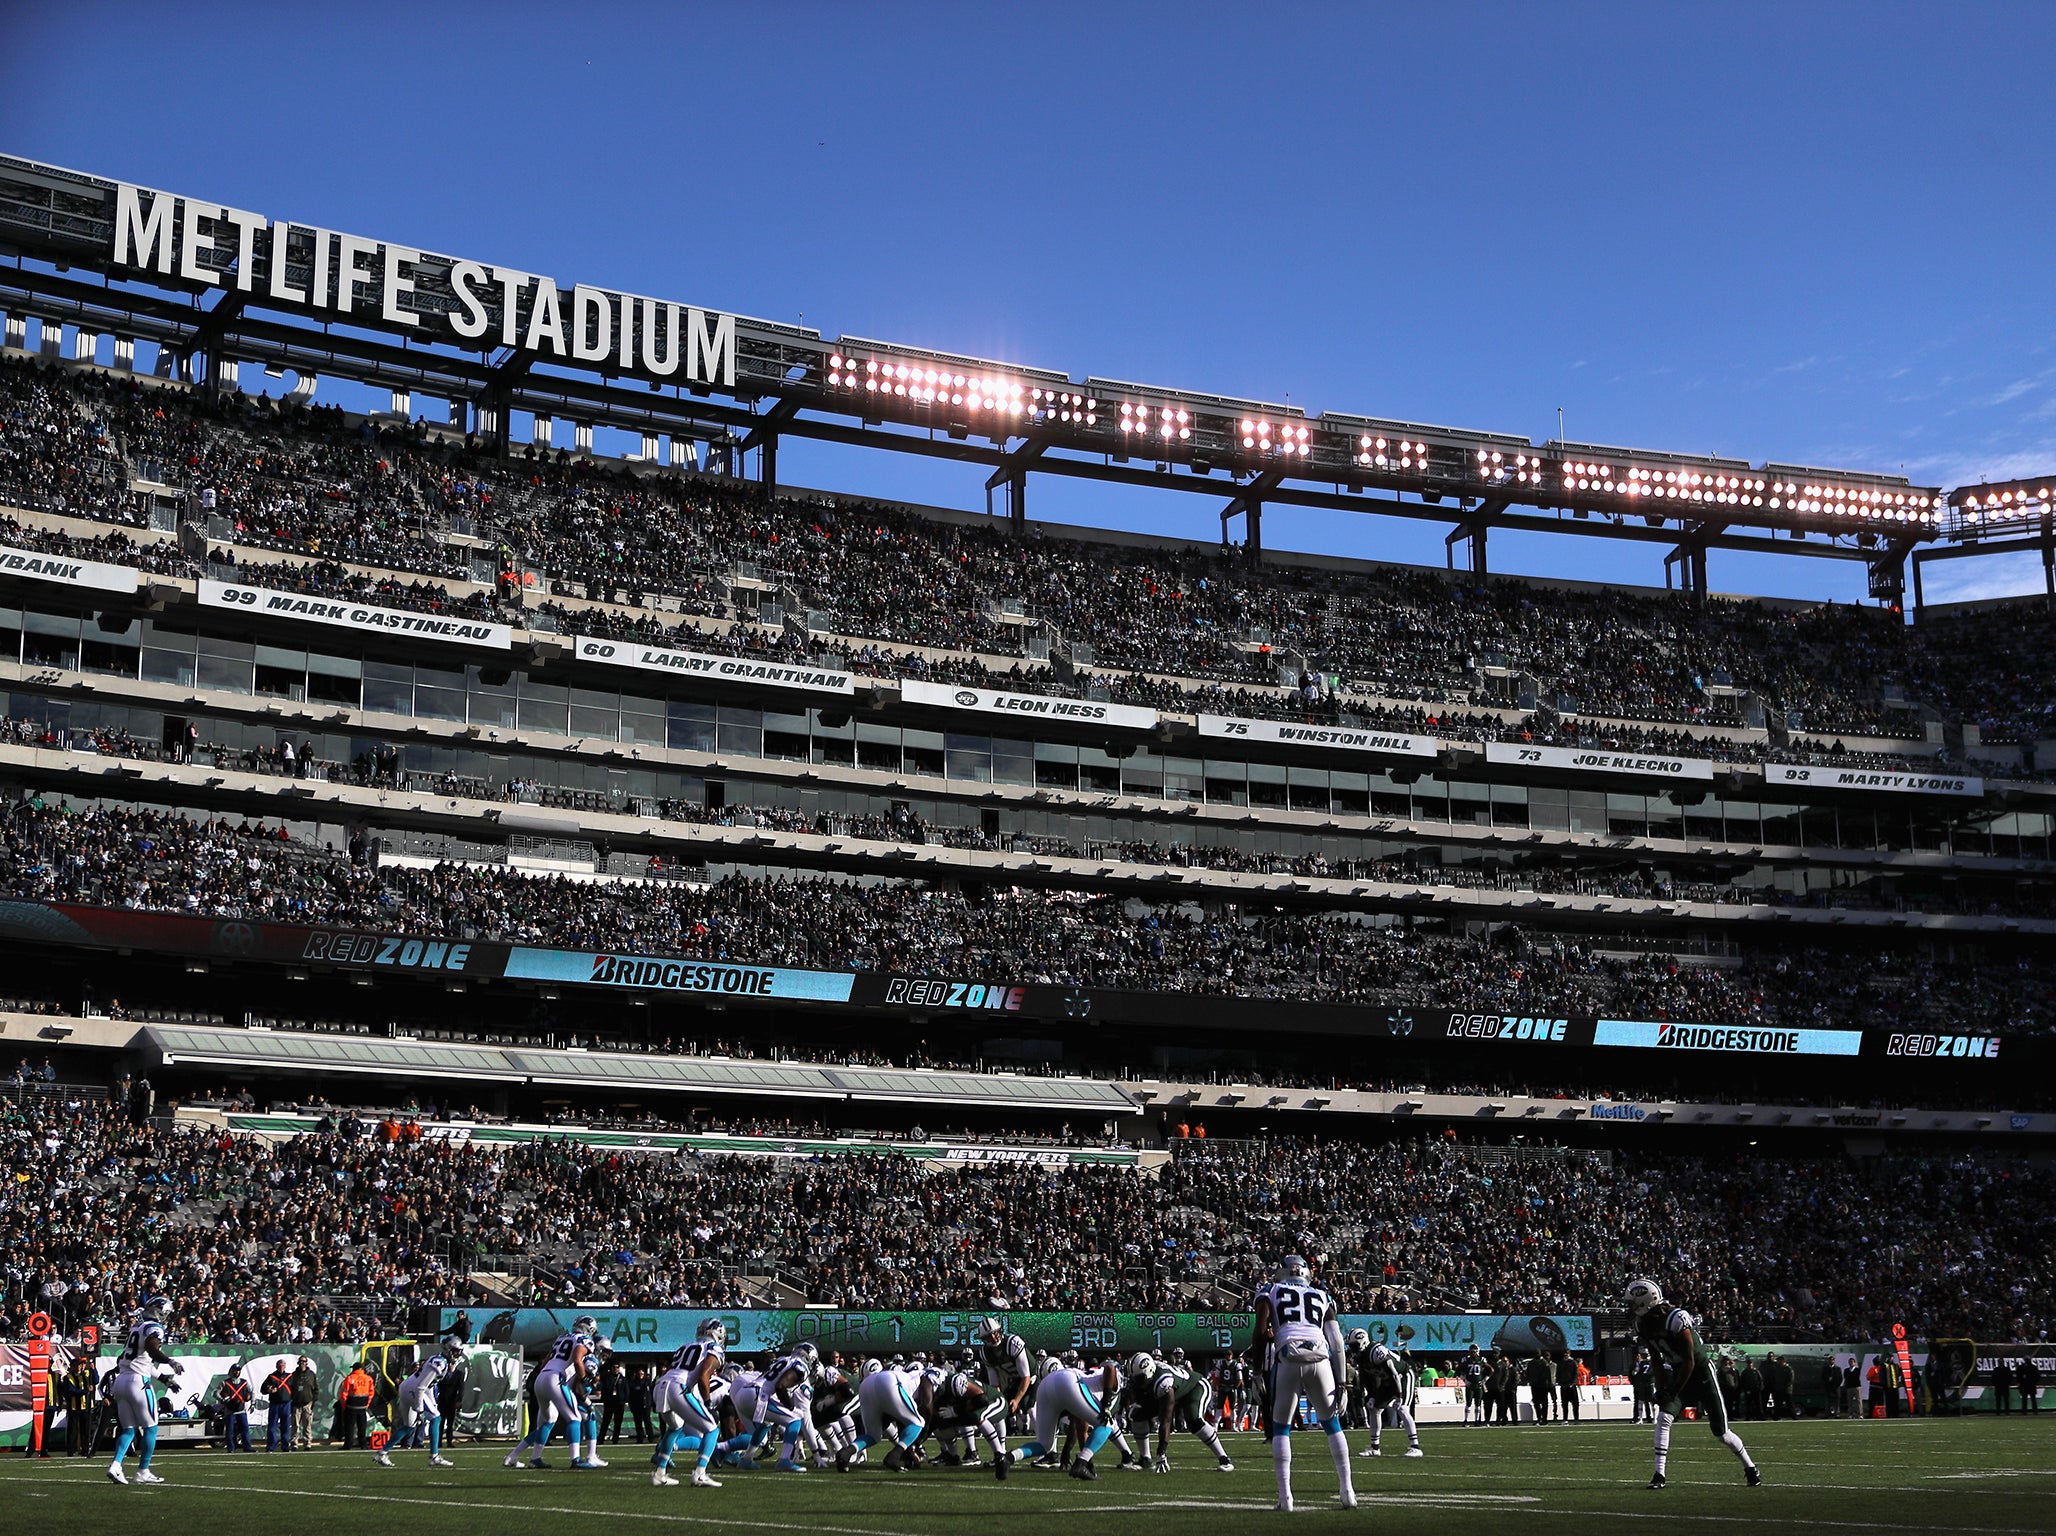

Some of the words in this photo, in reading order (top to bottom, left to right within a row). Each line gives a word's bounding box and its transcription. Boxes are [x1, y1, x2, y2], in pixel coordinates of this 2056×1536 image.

[113, 184, 421, 326] METLIFE
[448, 260, 736, 387] STADIUM
[221, 588, 257, 605] 99
[266, 596, 348, 620] MARK
[350, 609, 492, 640] GASTINEAU
[582, 642, 617, 658] 60
[640, 651, 718, 671] LARRY
[718, 662, 847, 688] GRANTHAM
[993, 697, 1051, 714] LEON
[1053, 703, 1107, 719] HESS
[1223, 722, 1248, 735] 75
[1278, 727, 1366, 747] WINSTON
[1369, 735, 1412, 750] HILL
[1518, 750, 1542, 762] 73
[1572, 755, 1609, 768] JOE
[1611, 757, 1683, 772] KLECKO
[1784, 769, 1810, 780] 93
[1838, 773, 1904, 787] MARTY
[1906, 776, 1965, 790] LYONS
[303, 931, 471, 970] REDZONE
[589, 955, 775, 994] BRIDGESTONE
[886, 978, 1026, 1009] REDZONE
[1446, 1014, 1568, 1041] REDZONE
[1657, 1024, 1798, 1051] BRIDGESTONE
[1887, 1034, 2000, 1057] REDZONE
[1591, 1104, 1645, 1120] MetLife
[1833, 1113, 1878, 1126] verizon
[424, 1126, 472, 1139] JETS
[2011, 1117, 2028, 1128] SAP
[947, 1150, 982, 1159] NEW
[986, 1151, 1029, 1161] YORK
[1030, 1152, 1069, 1163] JETS
[1276, 1287, 1323, 1328] 26
[597, 1317, 658, 1343] AR
[795, 1312, 871, 1346] QTR
[887, 1315, 901, 1342] 1
[1073, 1315, 1114, 1327] DOWN
[1136, 1315, 1155, 1327] TO
[1156, 1315, 1176, 1327] GO
[1196, 1316, 1228, 1327] BALL
[1230, 1316, 1249, 1328] ON
[1567, 1319, 1588, 1330] TOL
[83, 1326, 97, 1344] 3
[1071, 1328, 1117, 1347] 3RD
[1152, 1329, 1162, 1347] 1
[1211, 1329, 1232, 1347] 13
[1426, 1322, 1475, 1343] NYJ
[1576, 1334, 1585, 1347] 3
[1223, 1369, 1231, 1380] 9
[1468, 1364, 1481, 1375] 70
[373, 1433, 388, 1447] 20
